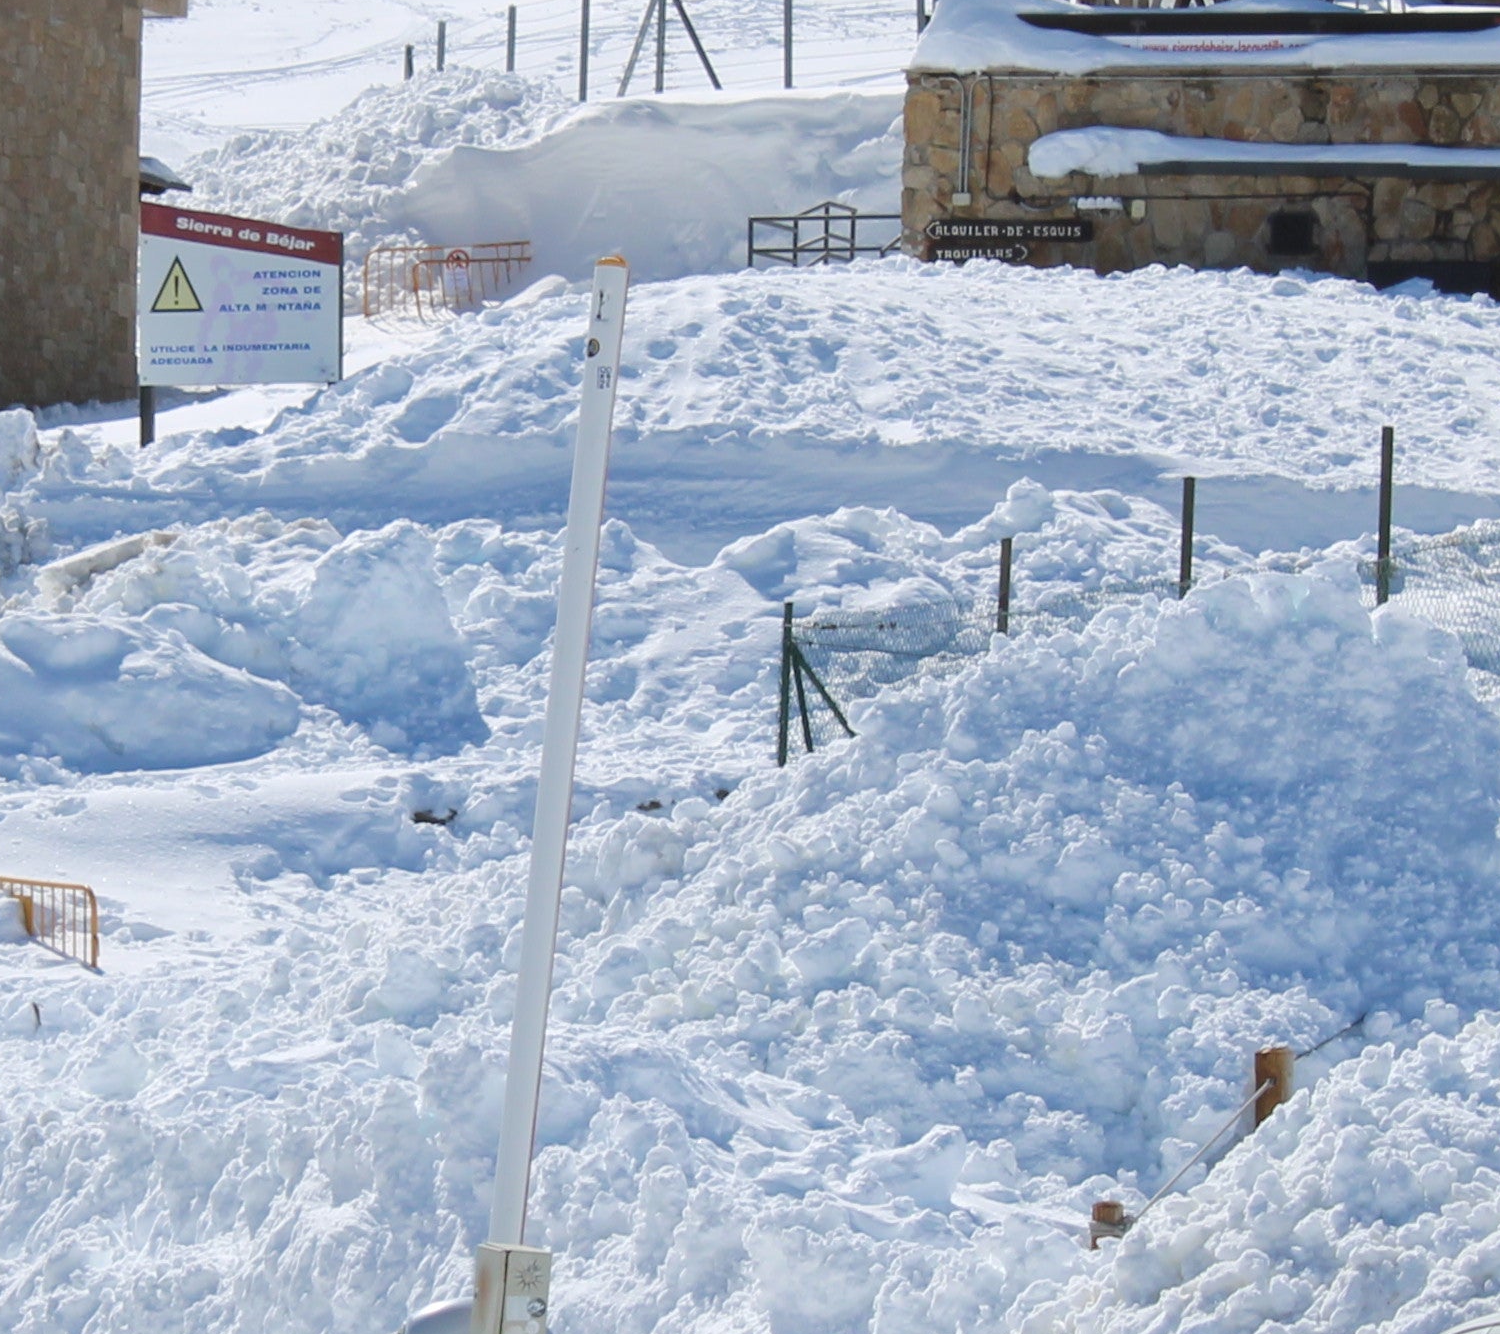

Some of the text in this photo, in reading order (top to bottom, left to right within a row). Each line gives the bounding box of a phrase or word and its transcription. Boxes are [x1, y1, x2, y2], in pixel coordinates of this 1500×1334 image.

[175, 216, 316, 251] Sierra de Béjar
[935, 225, 1081, 237] ALQUILER DE ESQUIS
[935, 248, 1013, 259] TAQUILLAS
[253, 270, 321, 279] ATENCION
[262, 286, 321, 295] ZONA DE
[219, 304, 251, 312] ALTA
[151, 343, 311, 353] UTILICE LA INDUMENTARIA
[151, 357, 213, 365] ADECUADA
